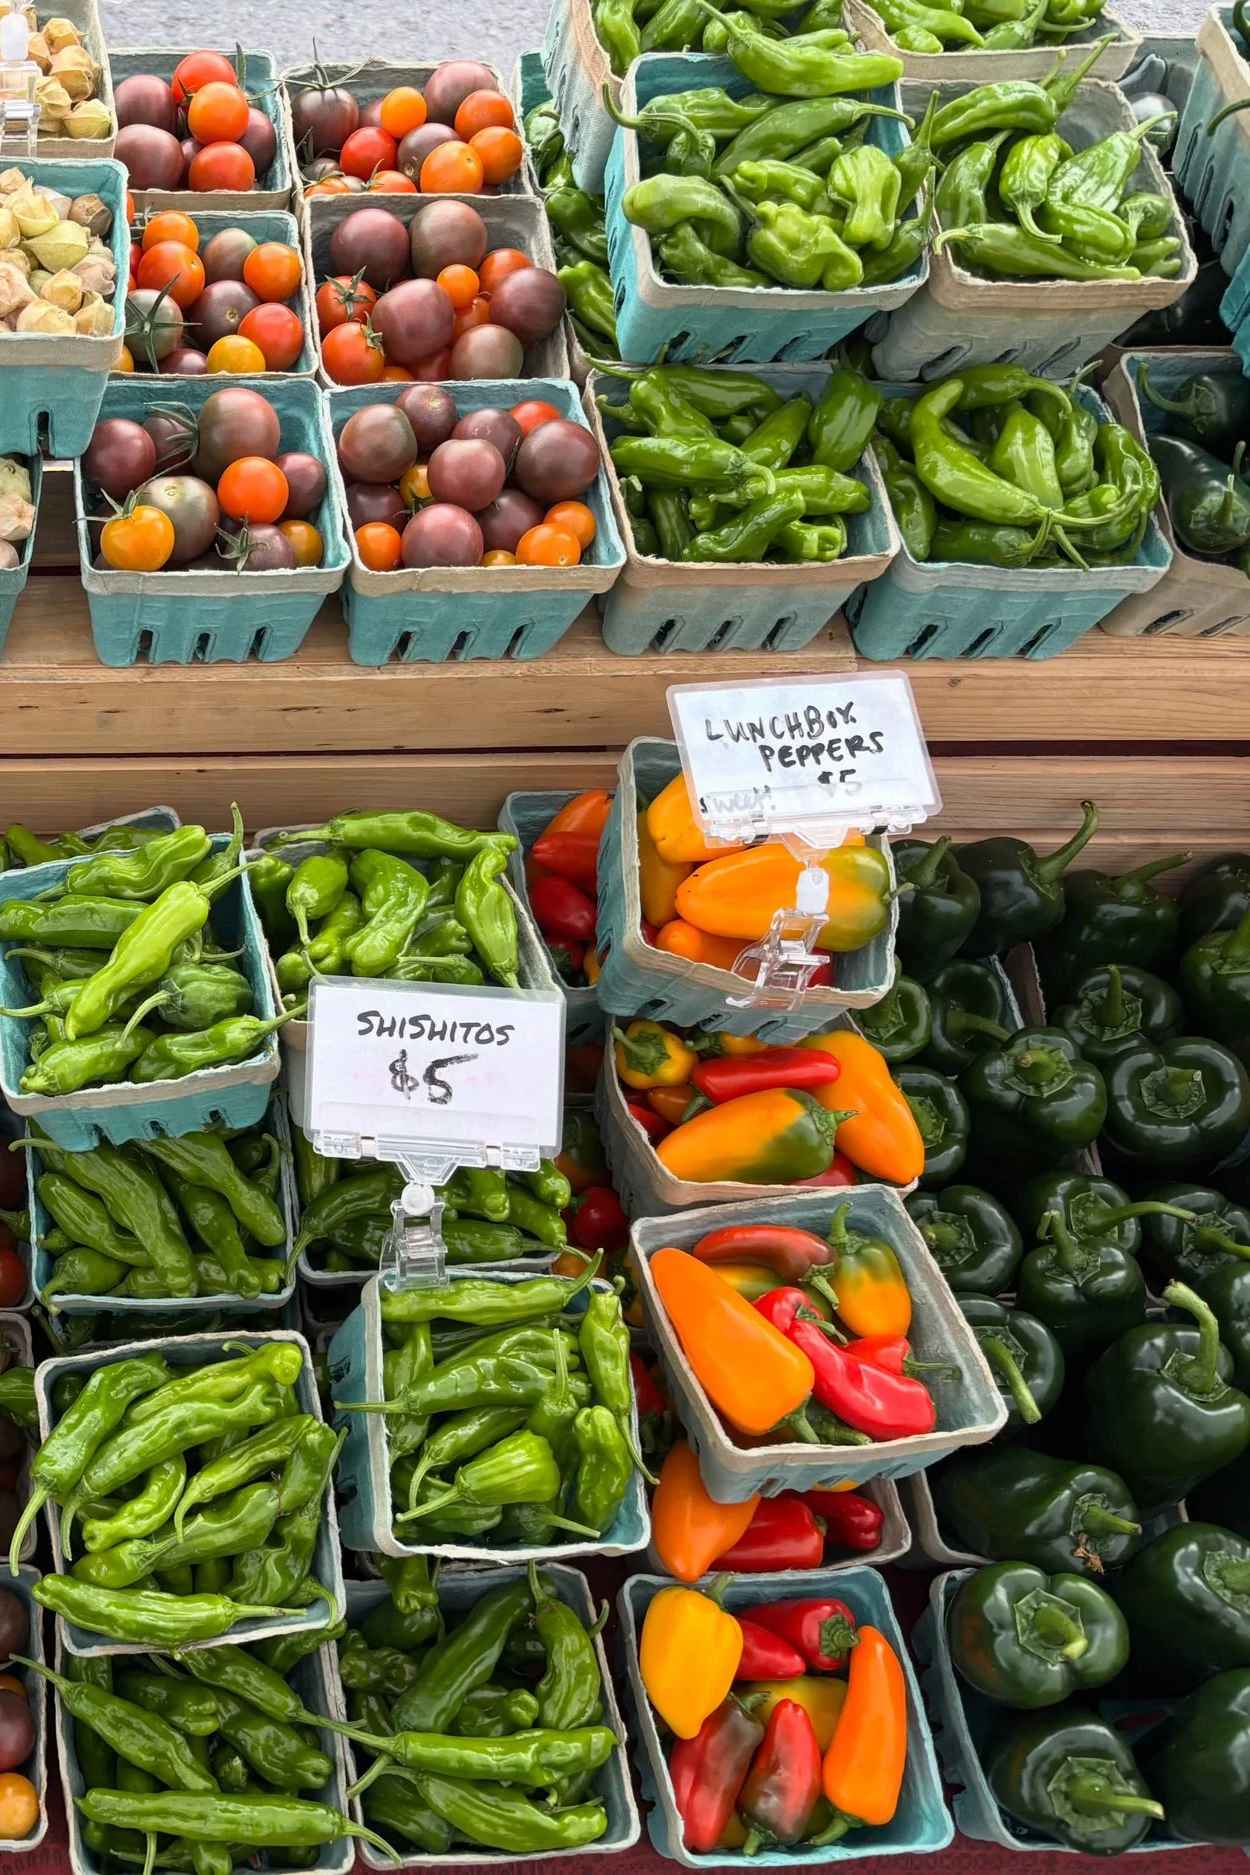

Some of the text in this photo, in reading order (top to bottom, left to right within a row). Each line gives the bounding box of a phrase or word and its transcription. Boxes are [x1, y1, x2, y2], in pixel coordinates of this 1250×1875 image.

[758, 731, 884, 772] PEPPERS
[817, 768, 863, 798] $5
[357, 1010, 515, 1046] SHISHITOS
[388, 1048, 479, 1105] $5
